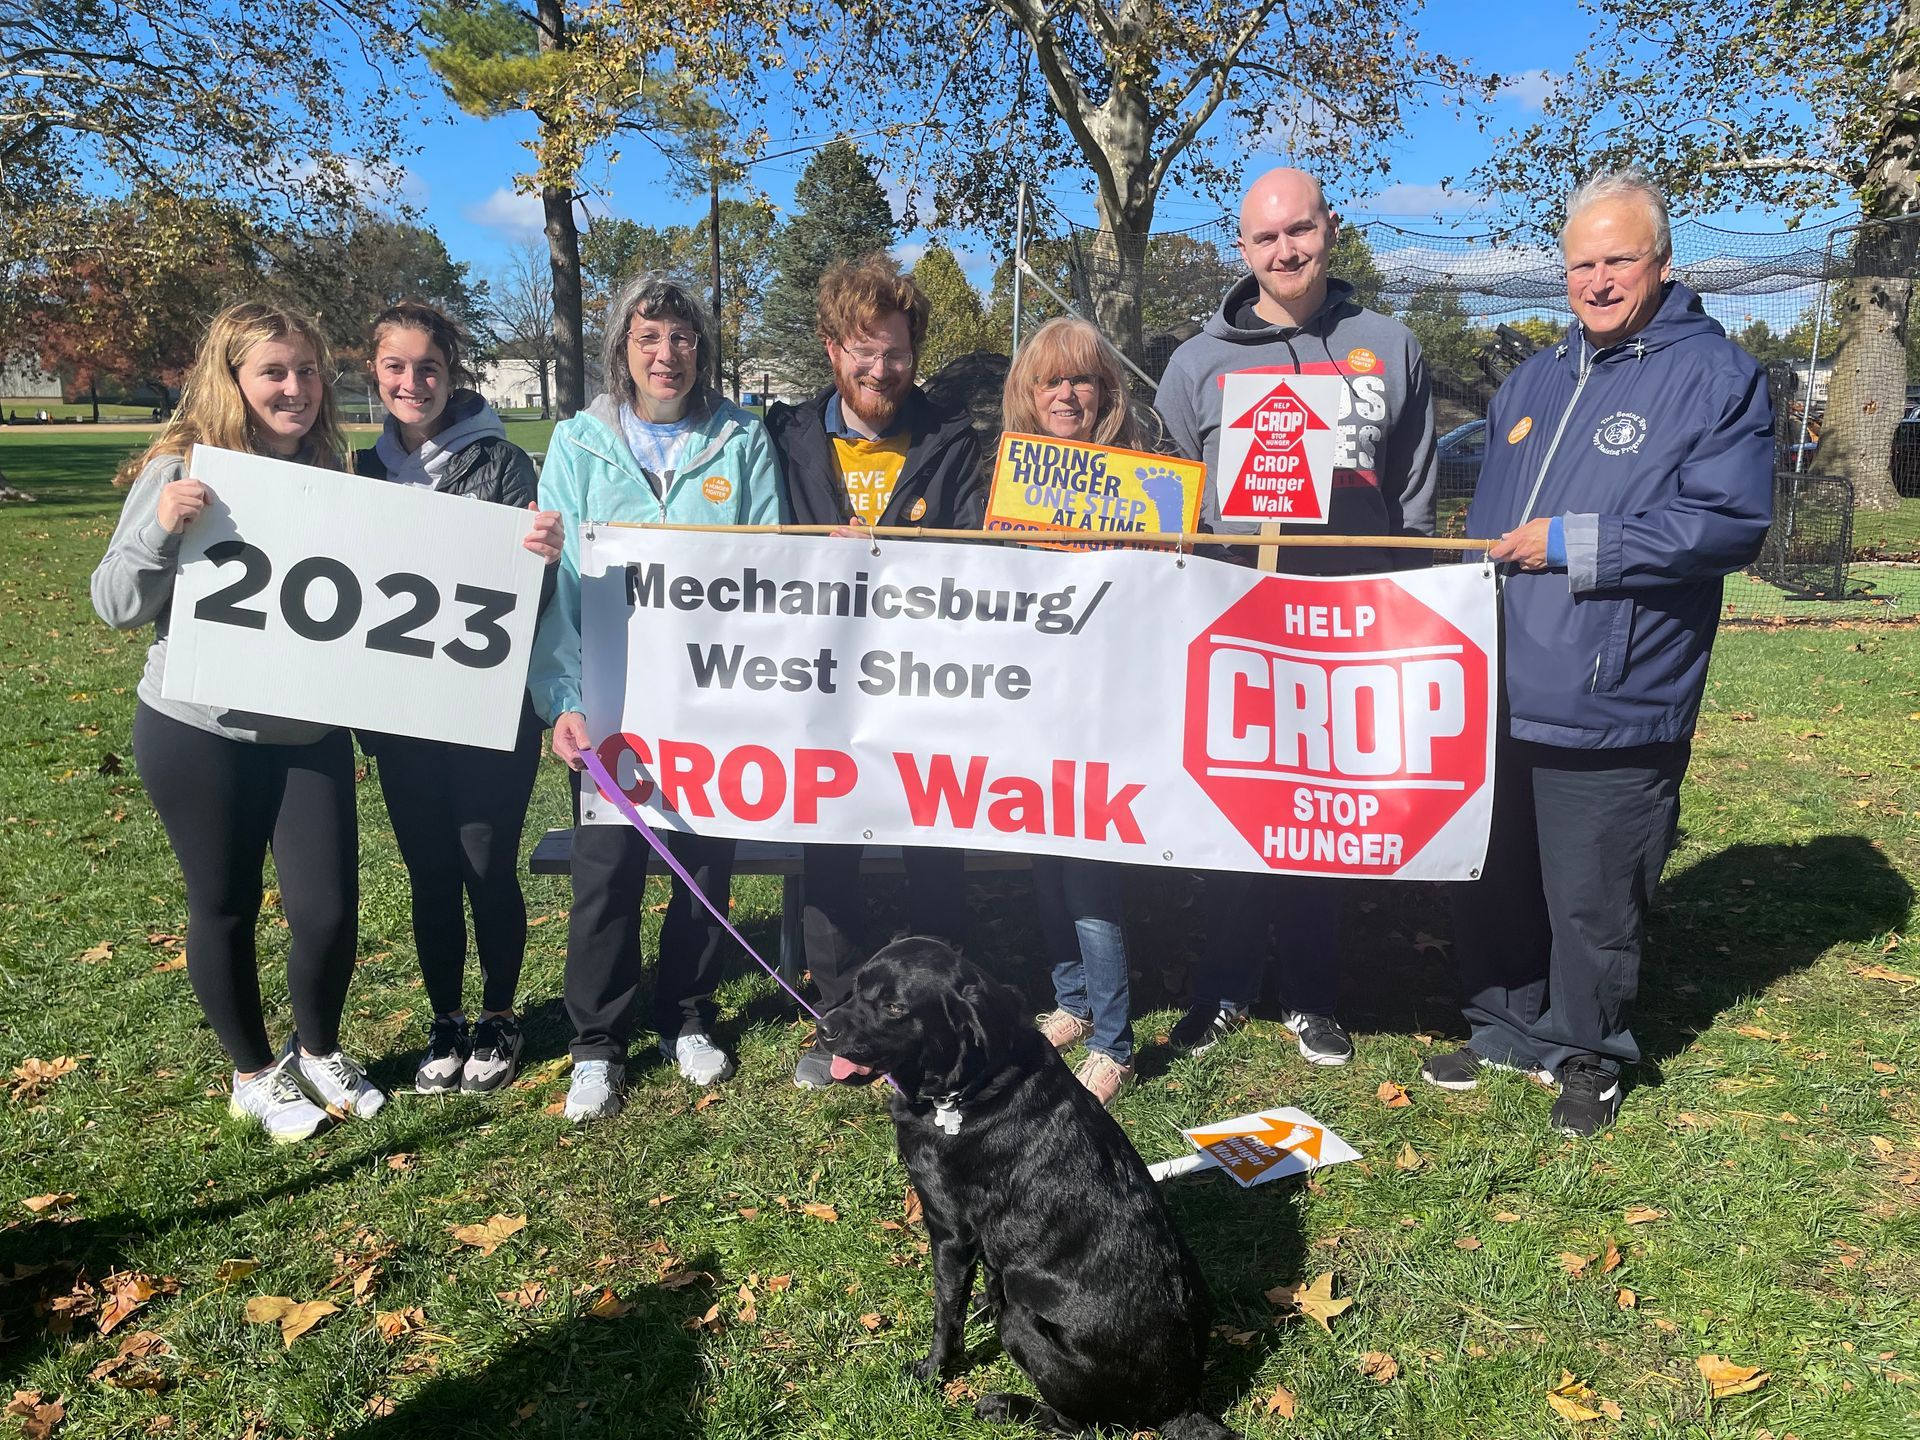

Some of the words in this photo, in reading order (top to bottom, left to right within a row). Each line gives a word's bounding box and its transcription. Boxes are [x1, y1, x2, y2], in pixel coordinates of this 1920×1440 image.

[1257, 411, 1303, 432] CROP
[1273, 402, 1291, 410] HELP
[1008, 440, 1108, 473] ENDING
[1253, 455, 1300, 473] CROP
[1013, 459, 1121, 497] HUNGER
[1244, 473, 1305, 494] Hunger
[1024, 484, 1078, 512] ONE
[1083, 493, 1147, 521] STEP
[1252, 495, 1294, 513] Walk
[1051, 509, 1076, 527] AT
[1079, 514, 1092, 530] A
[1098, 515, 1146, 532] TIME
[194, 540, 518, 669] 2023
[625, 561, 1113, 636] Mechanicsburg/
[1284, 604, 1376, 638] HELP
[686, 643, 838, 694] West
[857, 649, 1032, 701] Shore
[1206, 648, 1465, 776] CROP
[597, 732, 858, 824] CROP
[892, 751, 1147, 845] Walk
[1293, 787, 1379, 827] STOP
[1263, 825, 1404, 865] HUNGER
[1211, 1144, 1243, 1167] Walk
[1223, 1136, 1266, 1166] Hunger
[1243, 1135, 1278, 1157] CROP
